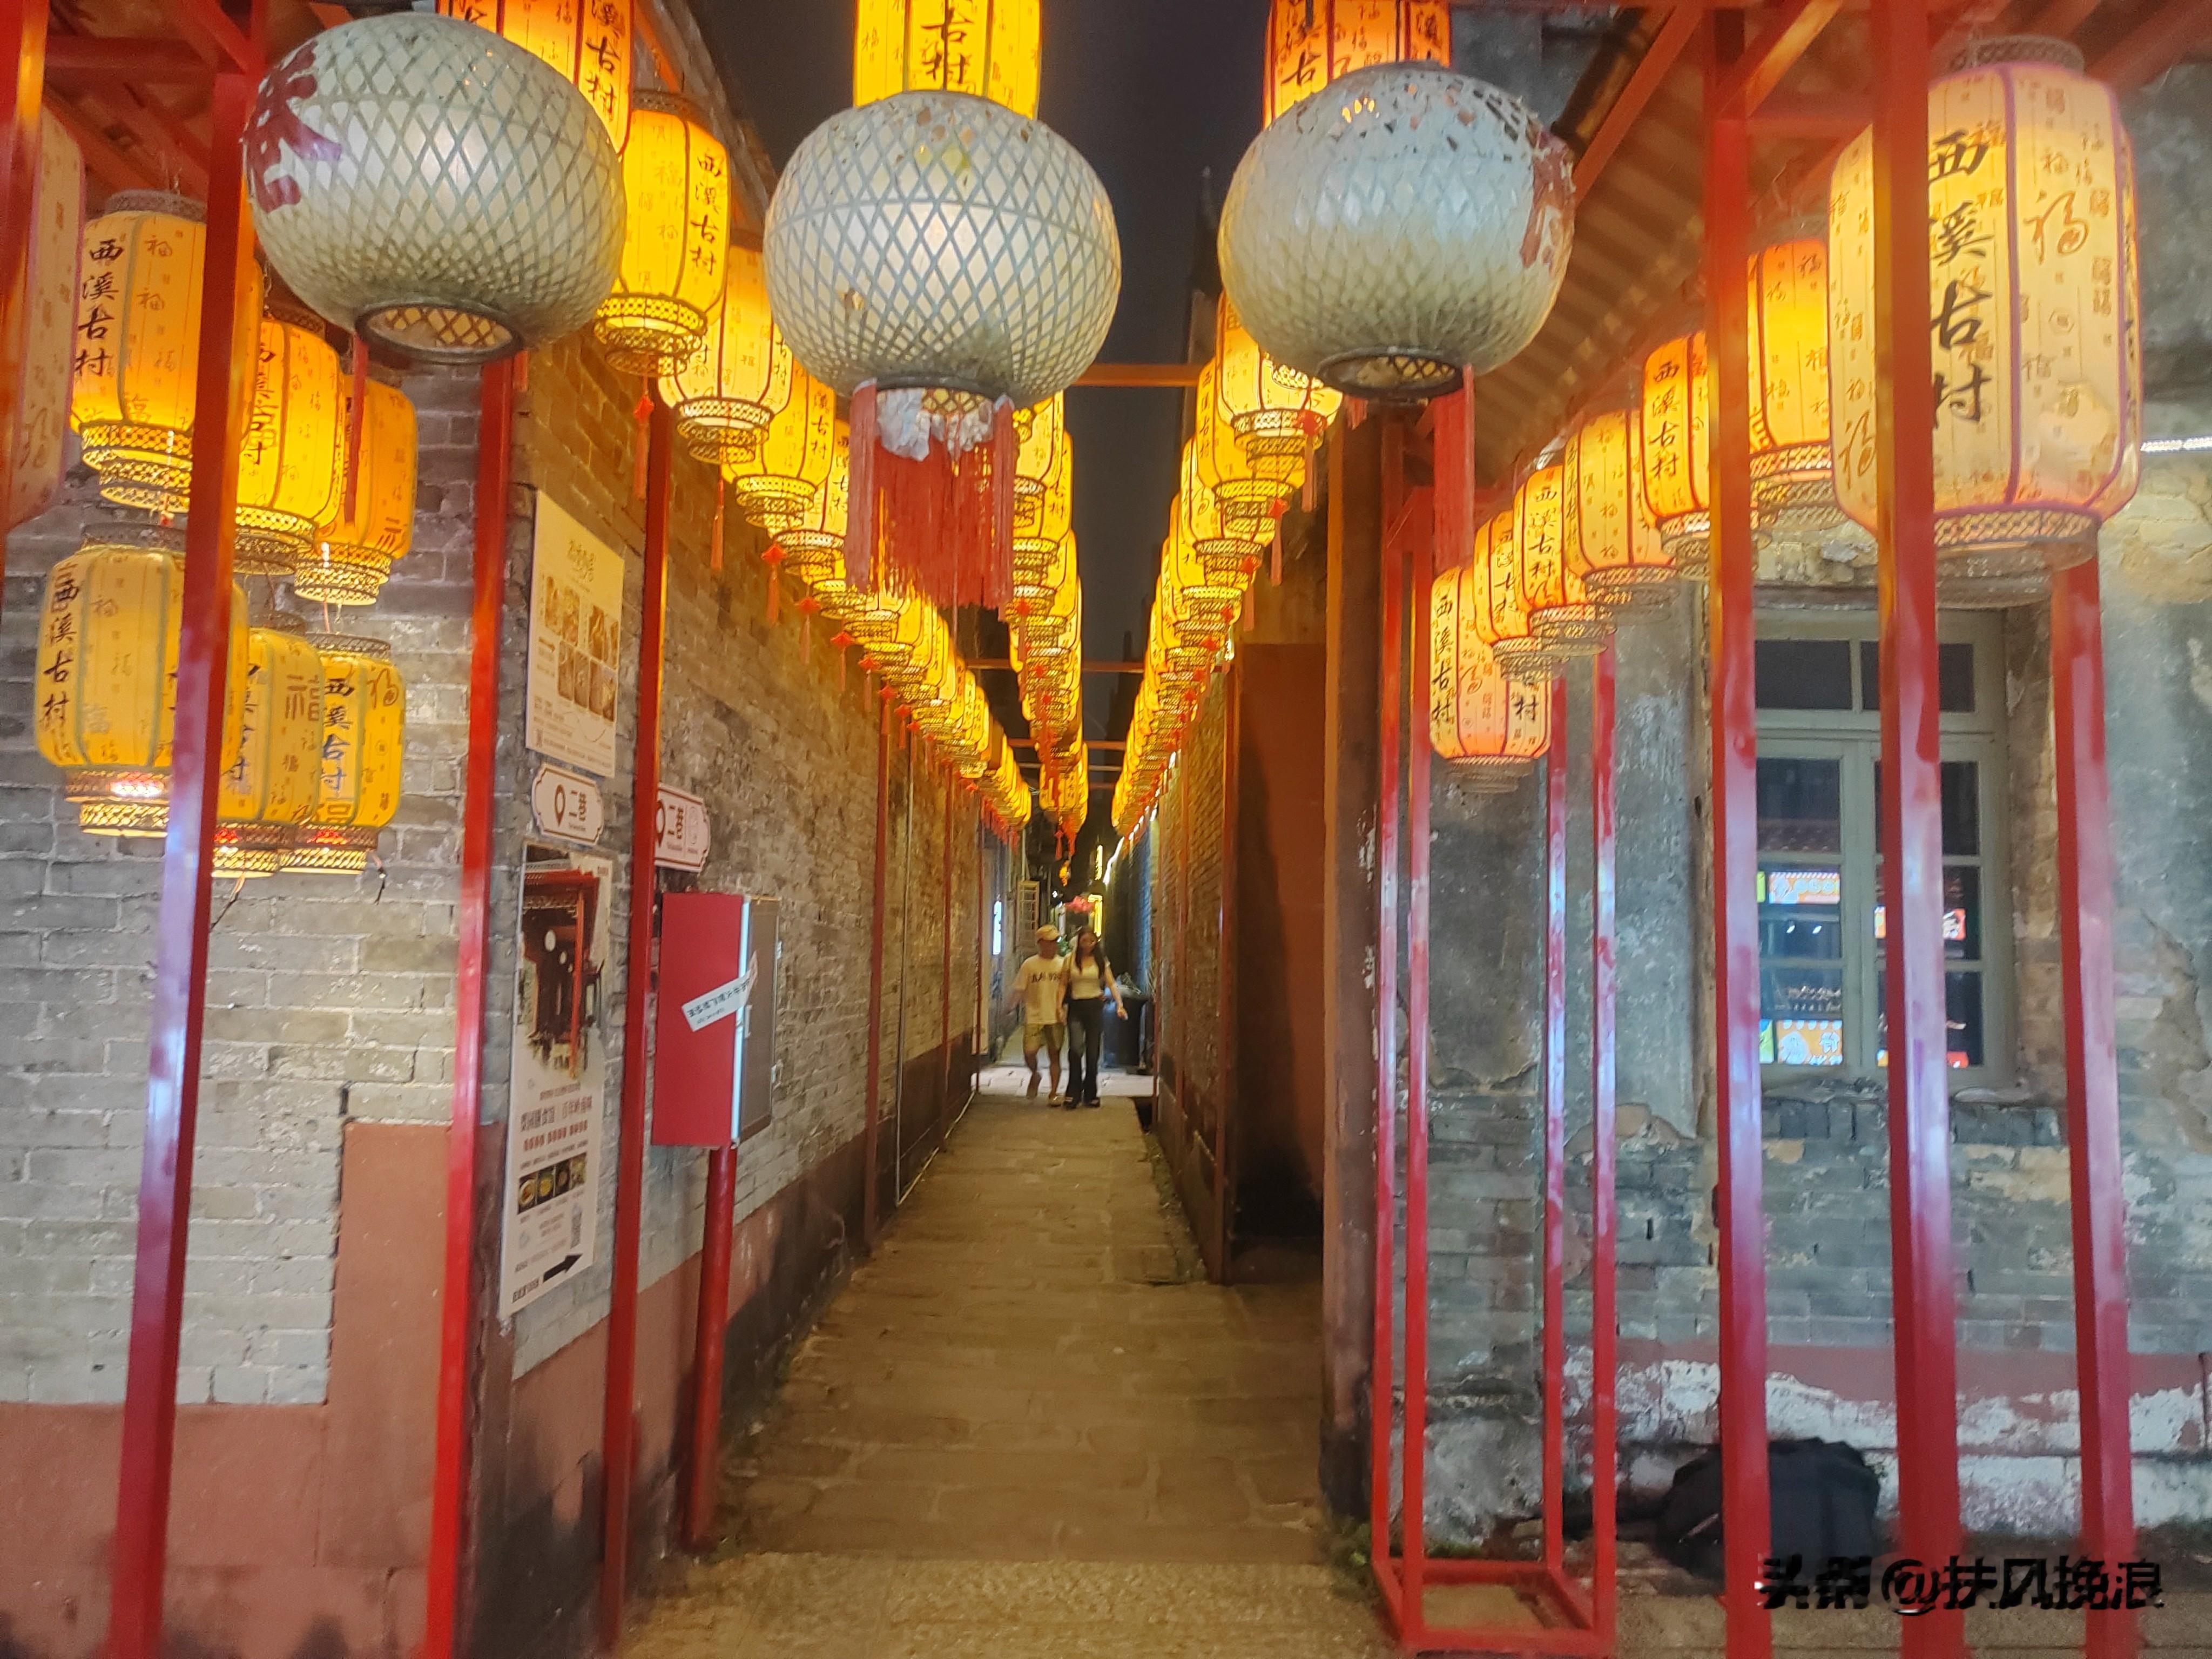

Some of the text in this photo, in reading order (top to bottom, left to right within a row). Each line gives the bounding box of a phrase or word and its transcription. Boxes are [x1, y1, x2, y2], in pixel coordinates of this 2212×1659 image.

[690, 151, 723, 276] 西溪古村
[75, 238, 124, 376] 西溪古村
[1928, 129, 1994, 429] 西溪古村
[1649, 360, 1681, 478] 西溪古村
[1528, 487, 1557, 577] 西溪古村
[43, 578, 80, 724] 西溪古村
[1432, 594, 1455, 723] 西溪古村
